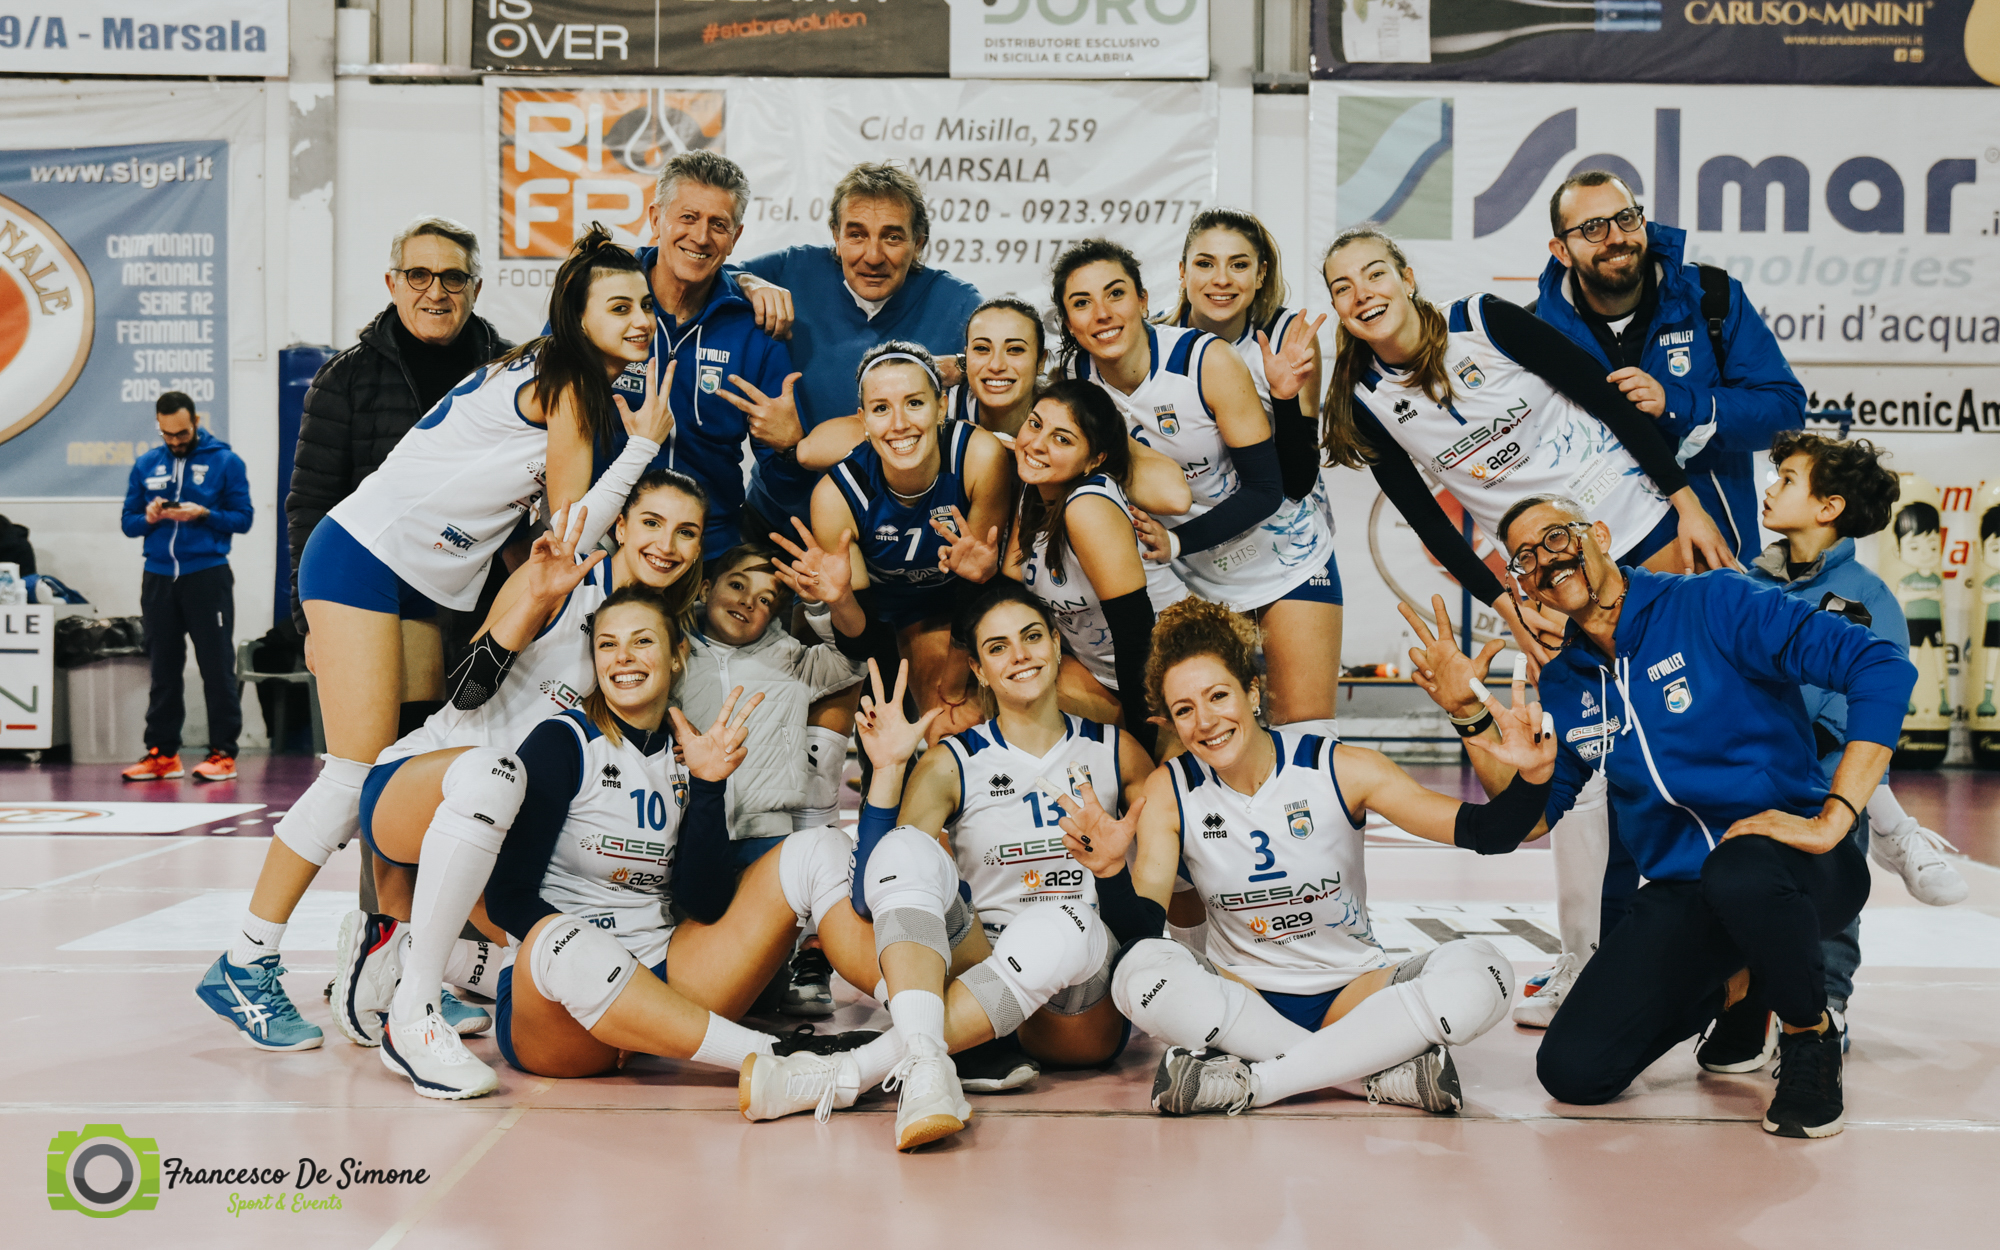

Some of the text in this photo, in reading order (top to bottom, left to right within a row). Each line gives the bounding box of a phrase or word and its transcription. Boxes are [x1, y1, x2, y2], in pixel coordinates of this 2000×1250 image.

[103, 17, 267, 52] Marsala
[702, 10, 867, 43] #stabrevolution
[486, 23, 630, 61] OVER
[985, 38, 1160, 48] DISTRIBUTORE ESCLUSIVO
[1783, 35, 1924, 47] www.carusoeminini.it
[984, 53, 1134, 63] IN SICILIA E CALABRIA
[860, 116, 1098, 146] C/da Misilla, 259
[30, 156, 214, 189] www.sigel.it
[909, 157, 1050, 183] MARSALA
[754, 197, 799, 222] Tel.
[107, 233, 214, 259] CAMPIONATO
[122, 262, 214, 286] NAZIONALE
[139, 292, 214, 316] SERIE A2
[117, 320, 214, 344] FEMMINILE
[1670, 330, 1694, 345] VOLLEY
[133, 349, 214, 373] STAGIONE
[707, 349, 730, 364] VOLLEY
[121, 378, 214, 402] 2019-2020
[1398, 409, 1418, 425] errea
[1486, 442, 1521, 471] a29
[875, 533, 899, 542] errea
[904, 527, 922, 561] 7
[1230, 544, 1257, 564] HTS
[1309, 578, 1331, 586] errea
[1657, 652, 1686, 677] VOLLEY
[492, 766, 516, 784] errea
[602, 778, 622, 789] errea
[989, 787, 1016, 798] errea
[630, 788, 667, 832] 10
[1022, 791, 1067, 829] 13
[1203, 829, 1228, 839] errea
[999, 837, 1068, 859] GES
[1249, 830, 1276, 872] 3
[629, 872, 664, 887] a29
[1045, 869, 1084, 887] a29
[1220, 870, 1342, 906] GESAN
[1060, 902, 1086, 933] MIKASA
[1271, 911, 1314, 931] a29
[552, 927, 581, 956] MIKASA
[467, 941, 490, 986] errea
[1141, 978, 1168, 1009] MIKASA
